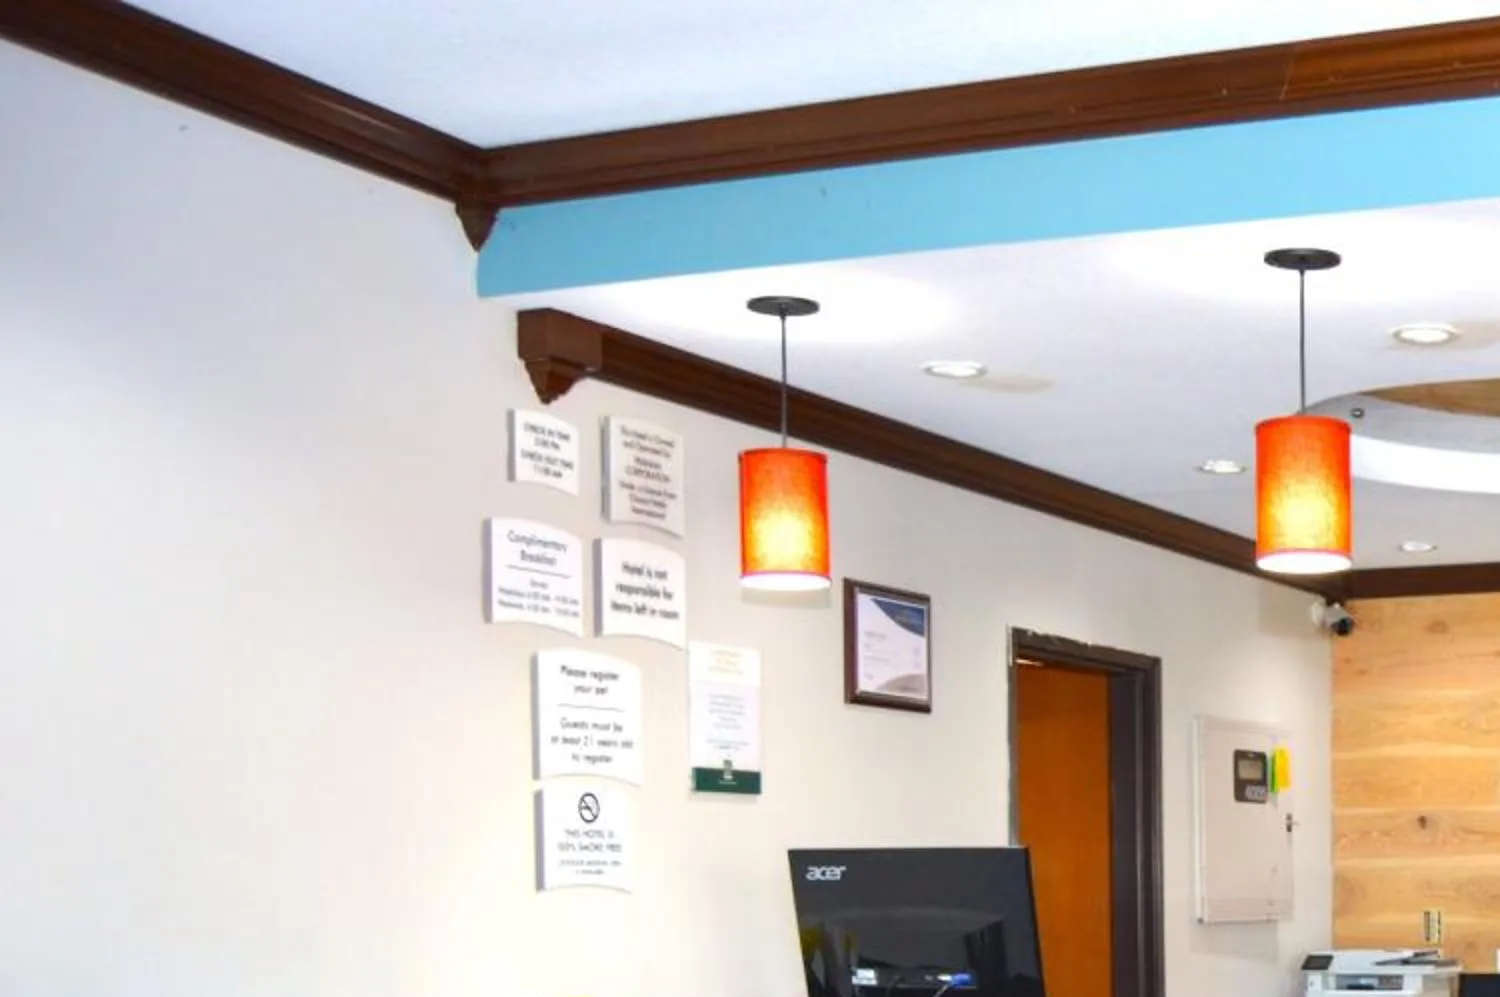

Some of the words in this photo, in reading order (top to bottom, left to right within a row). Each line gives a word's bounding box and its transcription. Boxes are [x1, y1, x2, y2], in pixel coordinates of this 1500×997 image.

[507, 529, 568, 554] Complimentary
[520, 549, 557, 566] Breakfast
[621, 560, 645, 577] Hotel
[654, 568, 668, 580] not
[615, 582, 660, 599] responsible
[662, 585, 674, 600] for
[611, 599, 633, 614] items
[634, 601, 648, 615] left
[659, 608, 680, 620] room
[560, 664, 587, 678] Please
[589, 671, 620, 683] register
[574, 685, 592, 694] your
[560, 716, 589, 730] Guests
[591, 721, 611, 731] must
[613, 721, 623, 733] be
[551, 735, 559, 744] at
[561, 735, 581, 746] least
[583, 734, 593, 747] 21
[597, 739, 618, 748] years
[621, 736, 634, 749] old
[572, 752, 580, 762] to
[584, 754, 614, 766] register
[806, 865, 847, 881] acer
